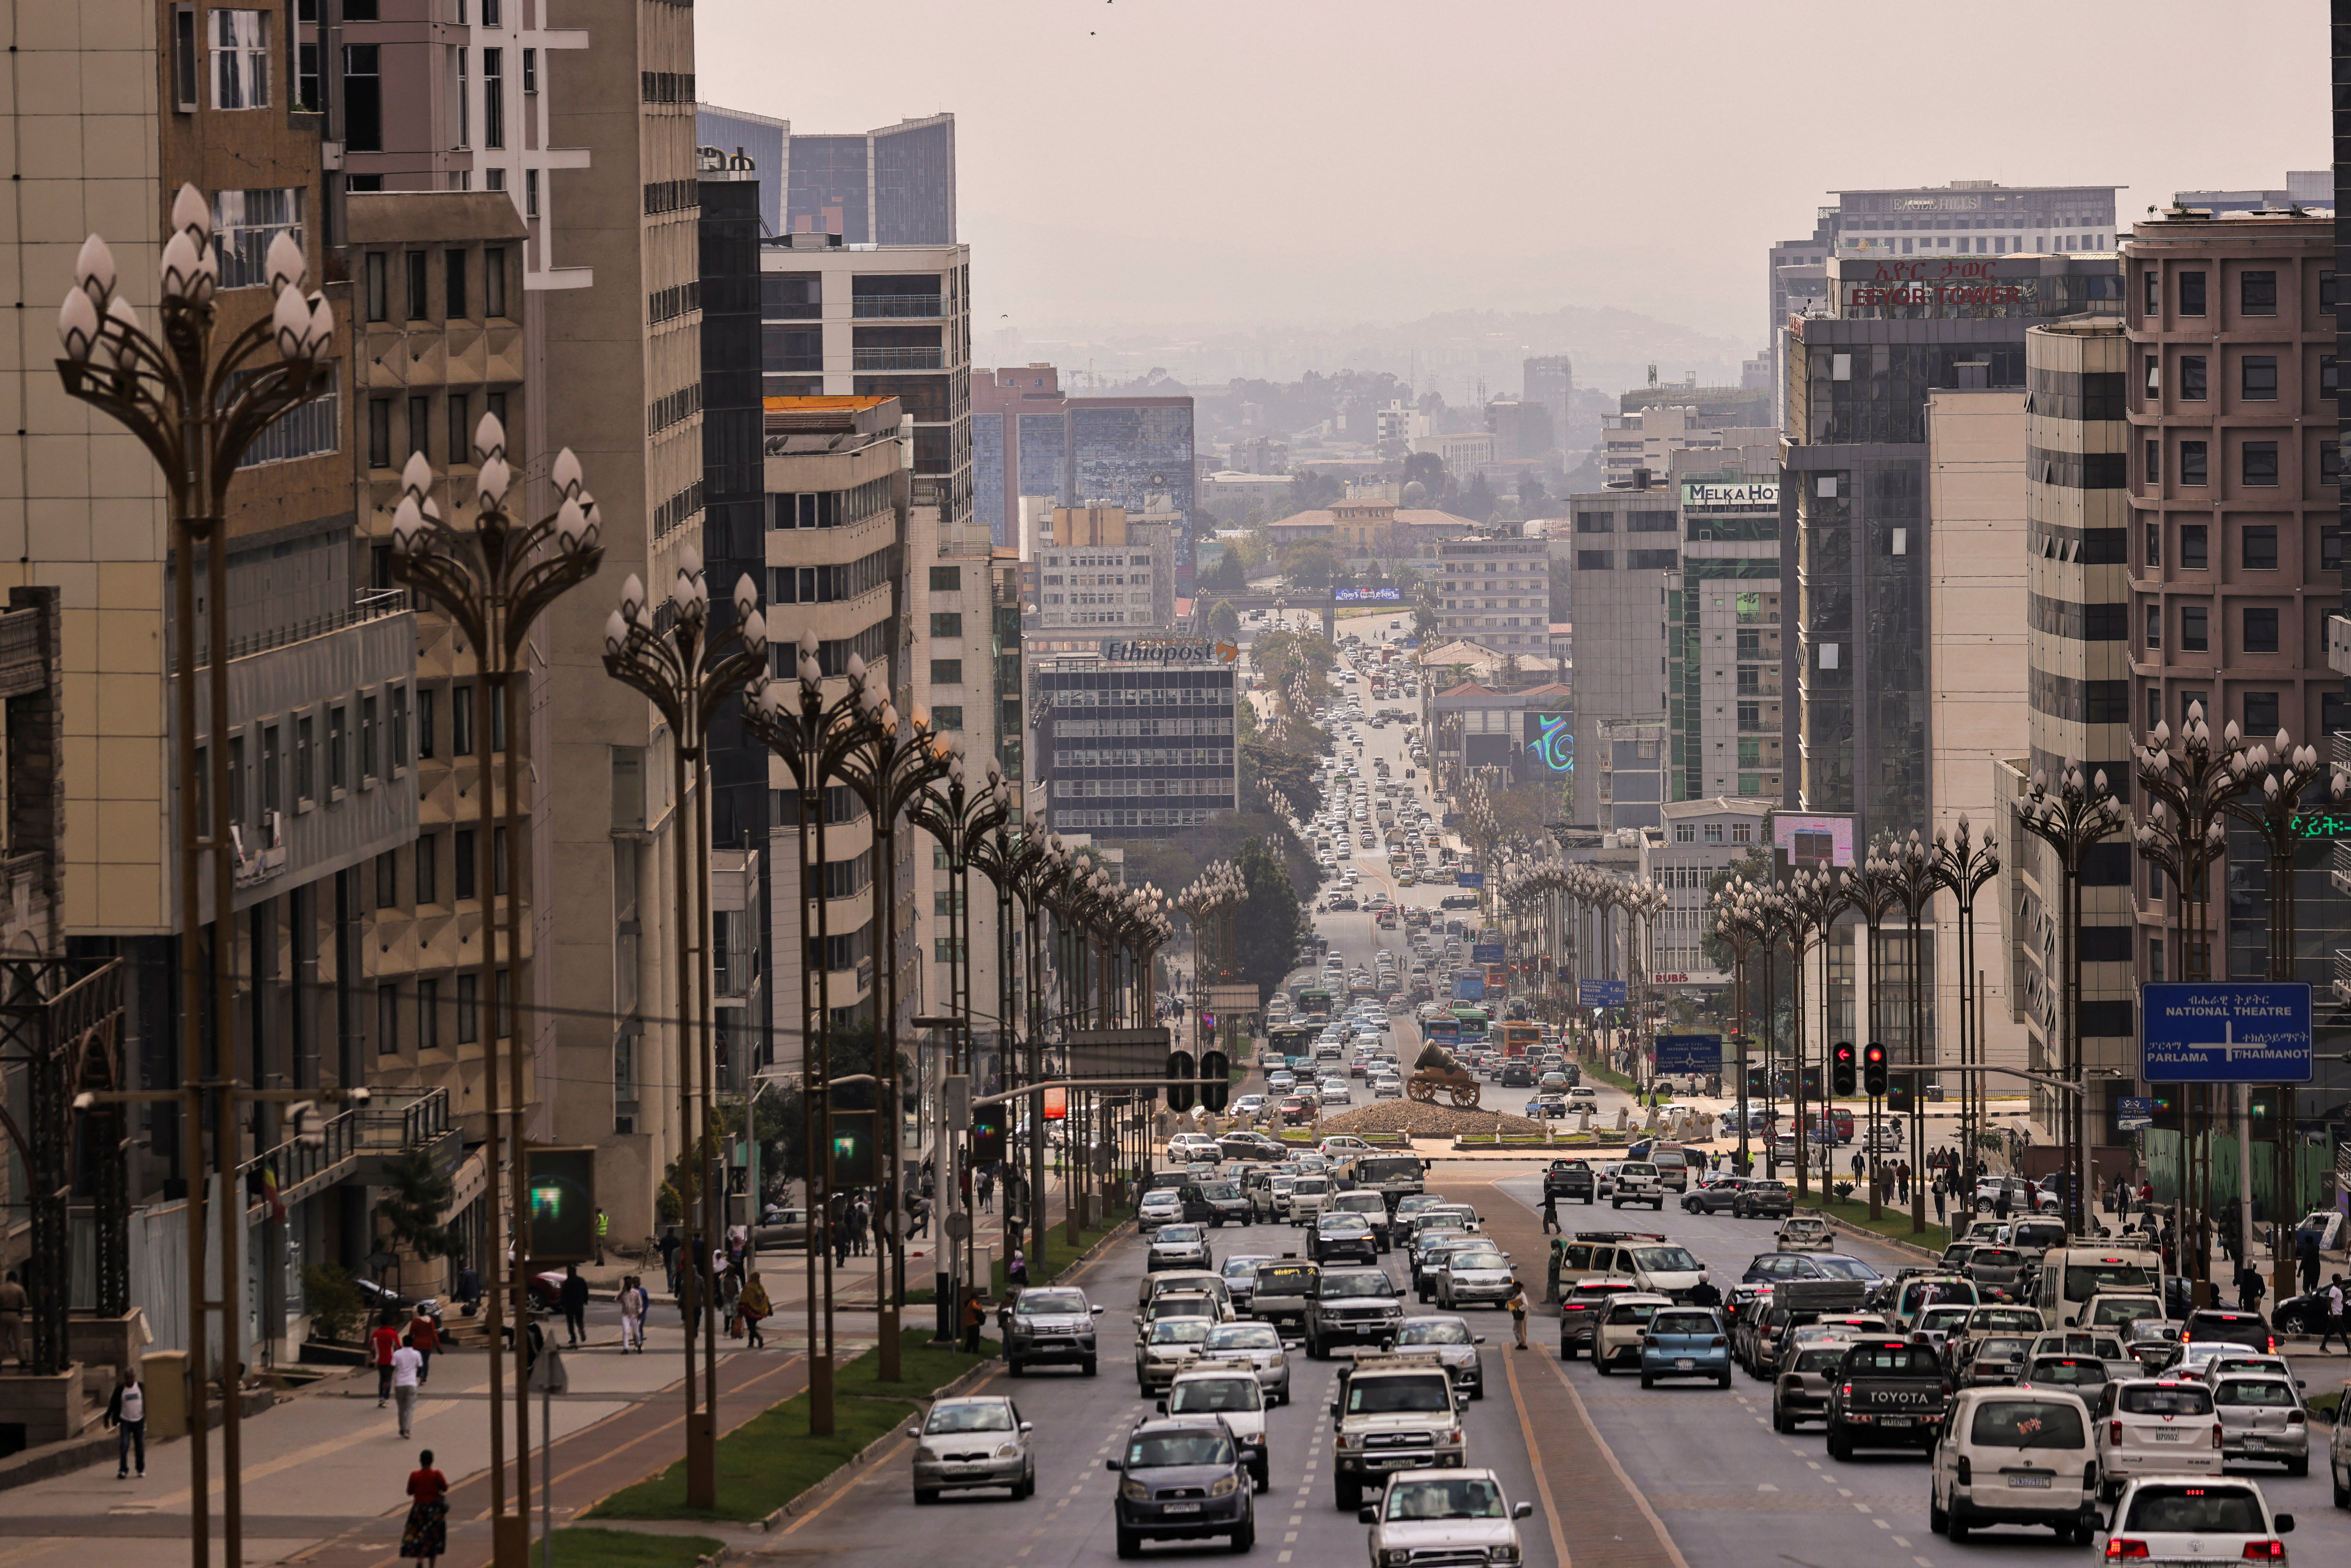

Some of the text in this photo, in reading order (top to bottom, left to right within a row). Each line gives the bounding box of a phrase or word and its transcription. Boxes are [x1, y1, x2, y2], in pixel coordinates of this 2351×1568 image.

[1893, 197, 1977, 211] EAGLE HILLS
[1875, 261, 1996, 281] ኢዮር ታወር
[1852, 286, 2021, 306] EEYOR TOWER
[1690, 485, 1745, 500] MELKA
[1108, 641, 1213, 666] Ethiopost
[2166, 1007, 2292, 1016] NATIONAL THEATRE
[2147, 1053, 2208, 1062] PARLAMA
[2233, 1049, 2310, 1059] T/HAIMANOT
[1870, 1391, 1928, 1404] TOYOTA
